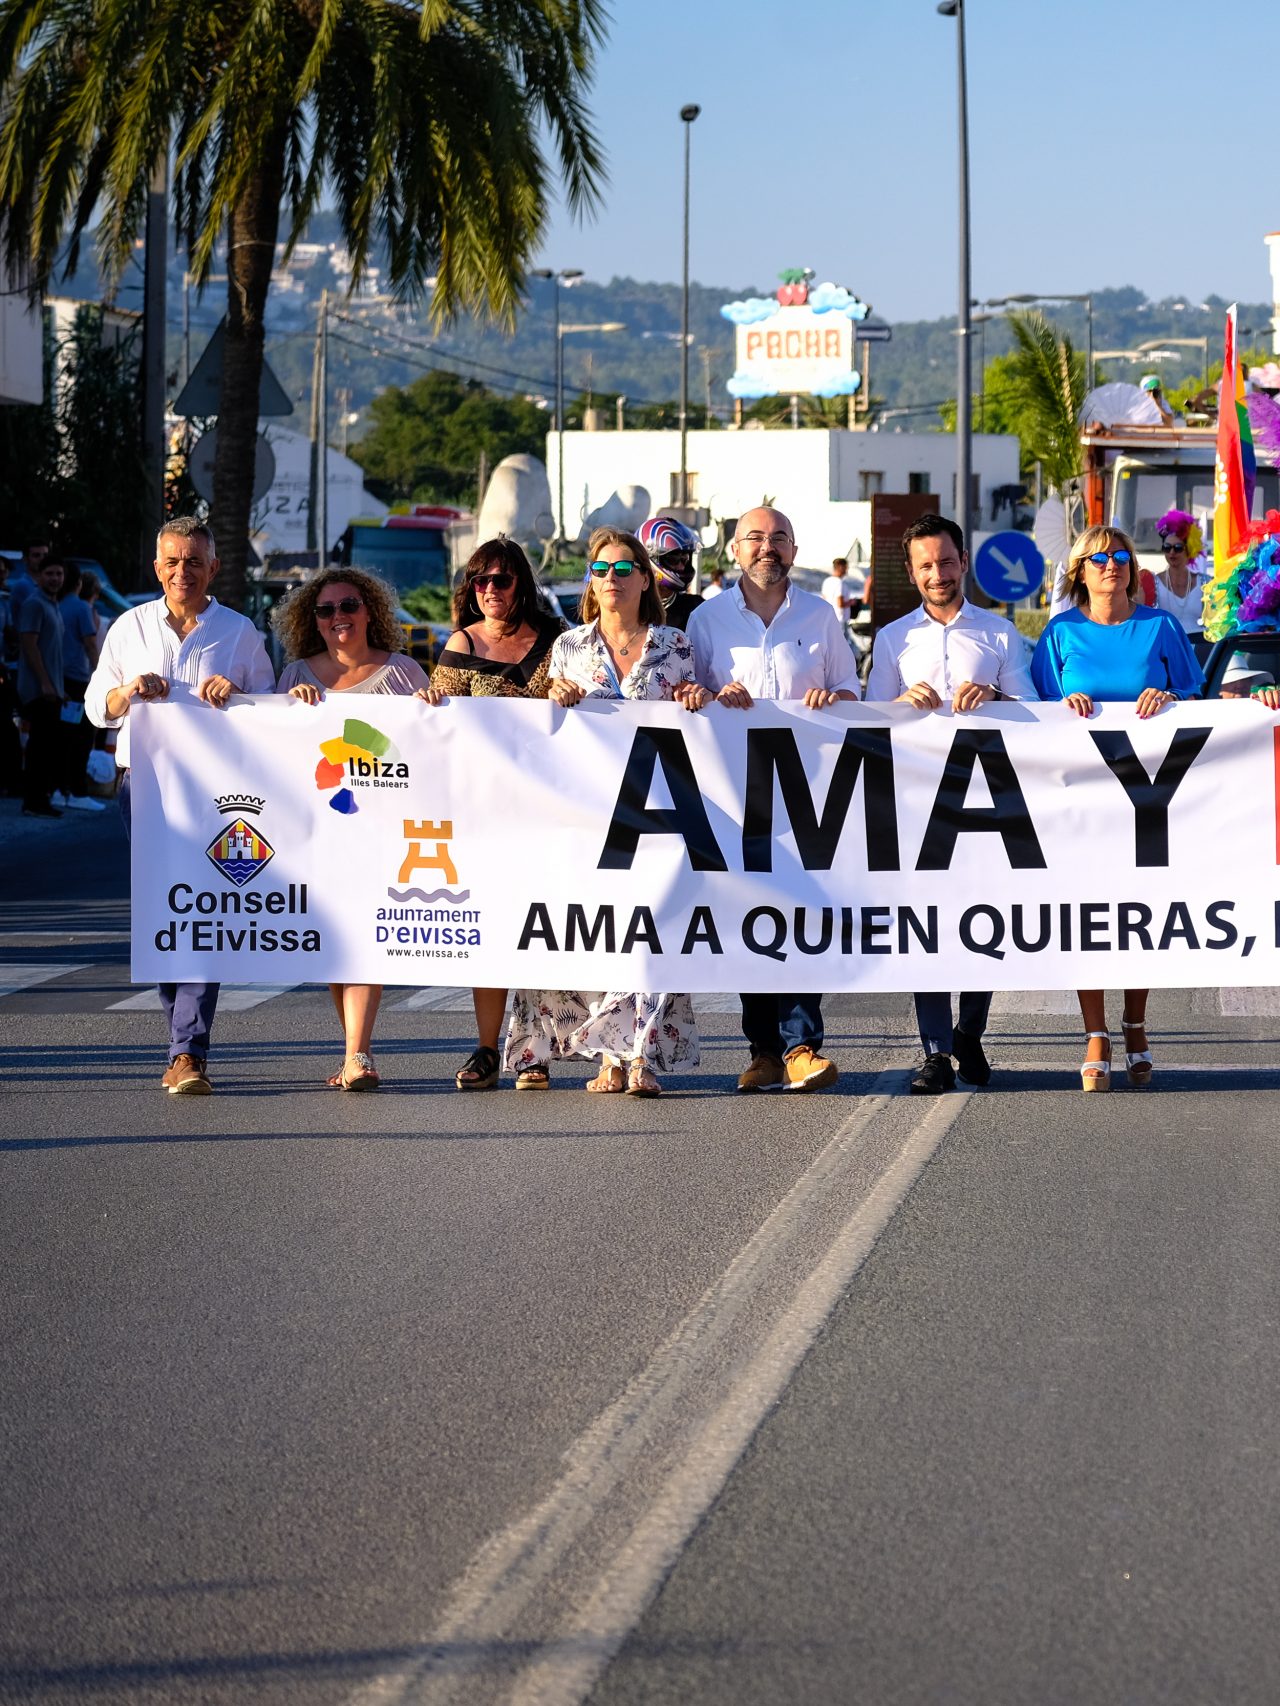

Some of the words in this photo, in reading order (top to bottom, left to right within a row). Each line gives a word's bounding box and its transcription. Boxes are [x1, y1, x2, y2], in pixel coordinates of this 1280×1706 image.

[747, 329, 841, 360] PACHA
[349, 757, 409, 778] Ibiza
[351, 778, 370, 787] Illes
[373, 780, 409, 789] Balears
[598, 726, 1048, 873] AMA
[1088, 727, 1213, 867] Y
[168, 884, 307, 915] Consell
[154, 920, 321, 952] d'Eivissa
[517, 902, 664, 955] AMA
[681, 906, 723, 955] A
[741, 905, 939, 962] QUIEN
[958, 900, 1256, 961] QUIERAS,
[387, 949, 469, 959] www.eivissa.es
